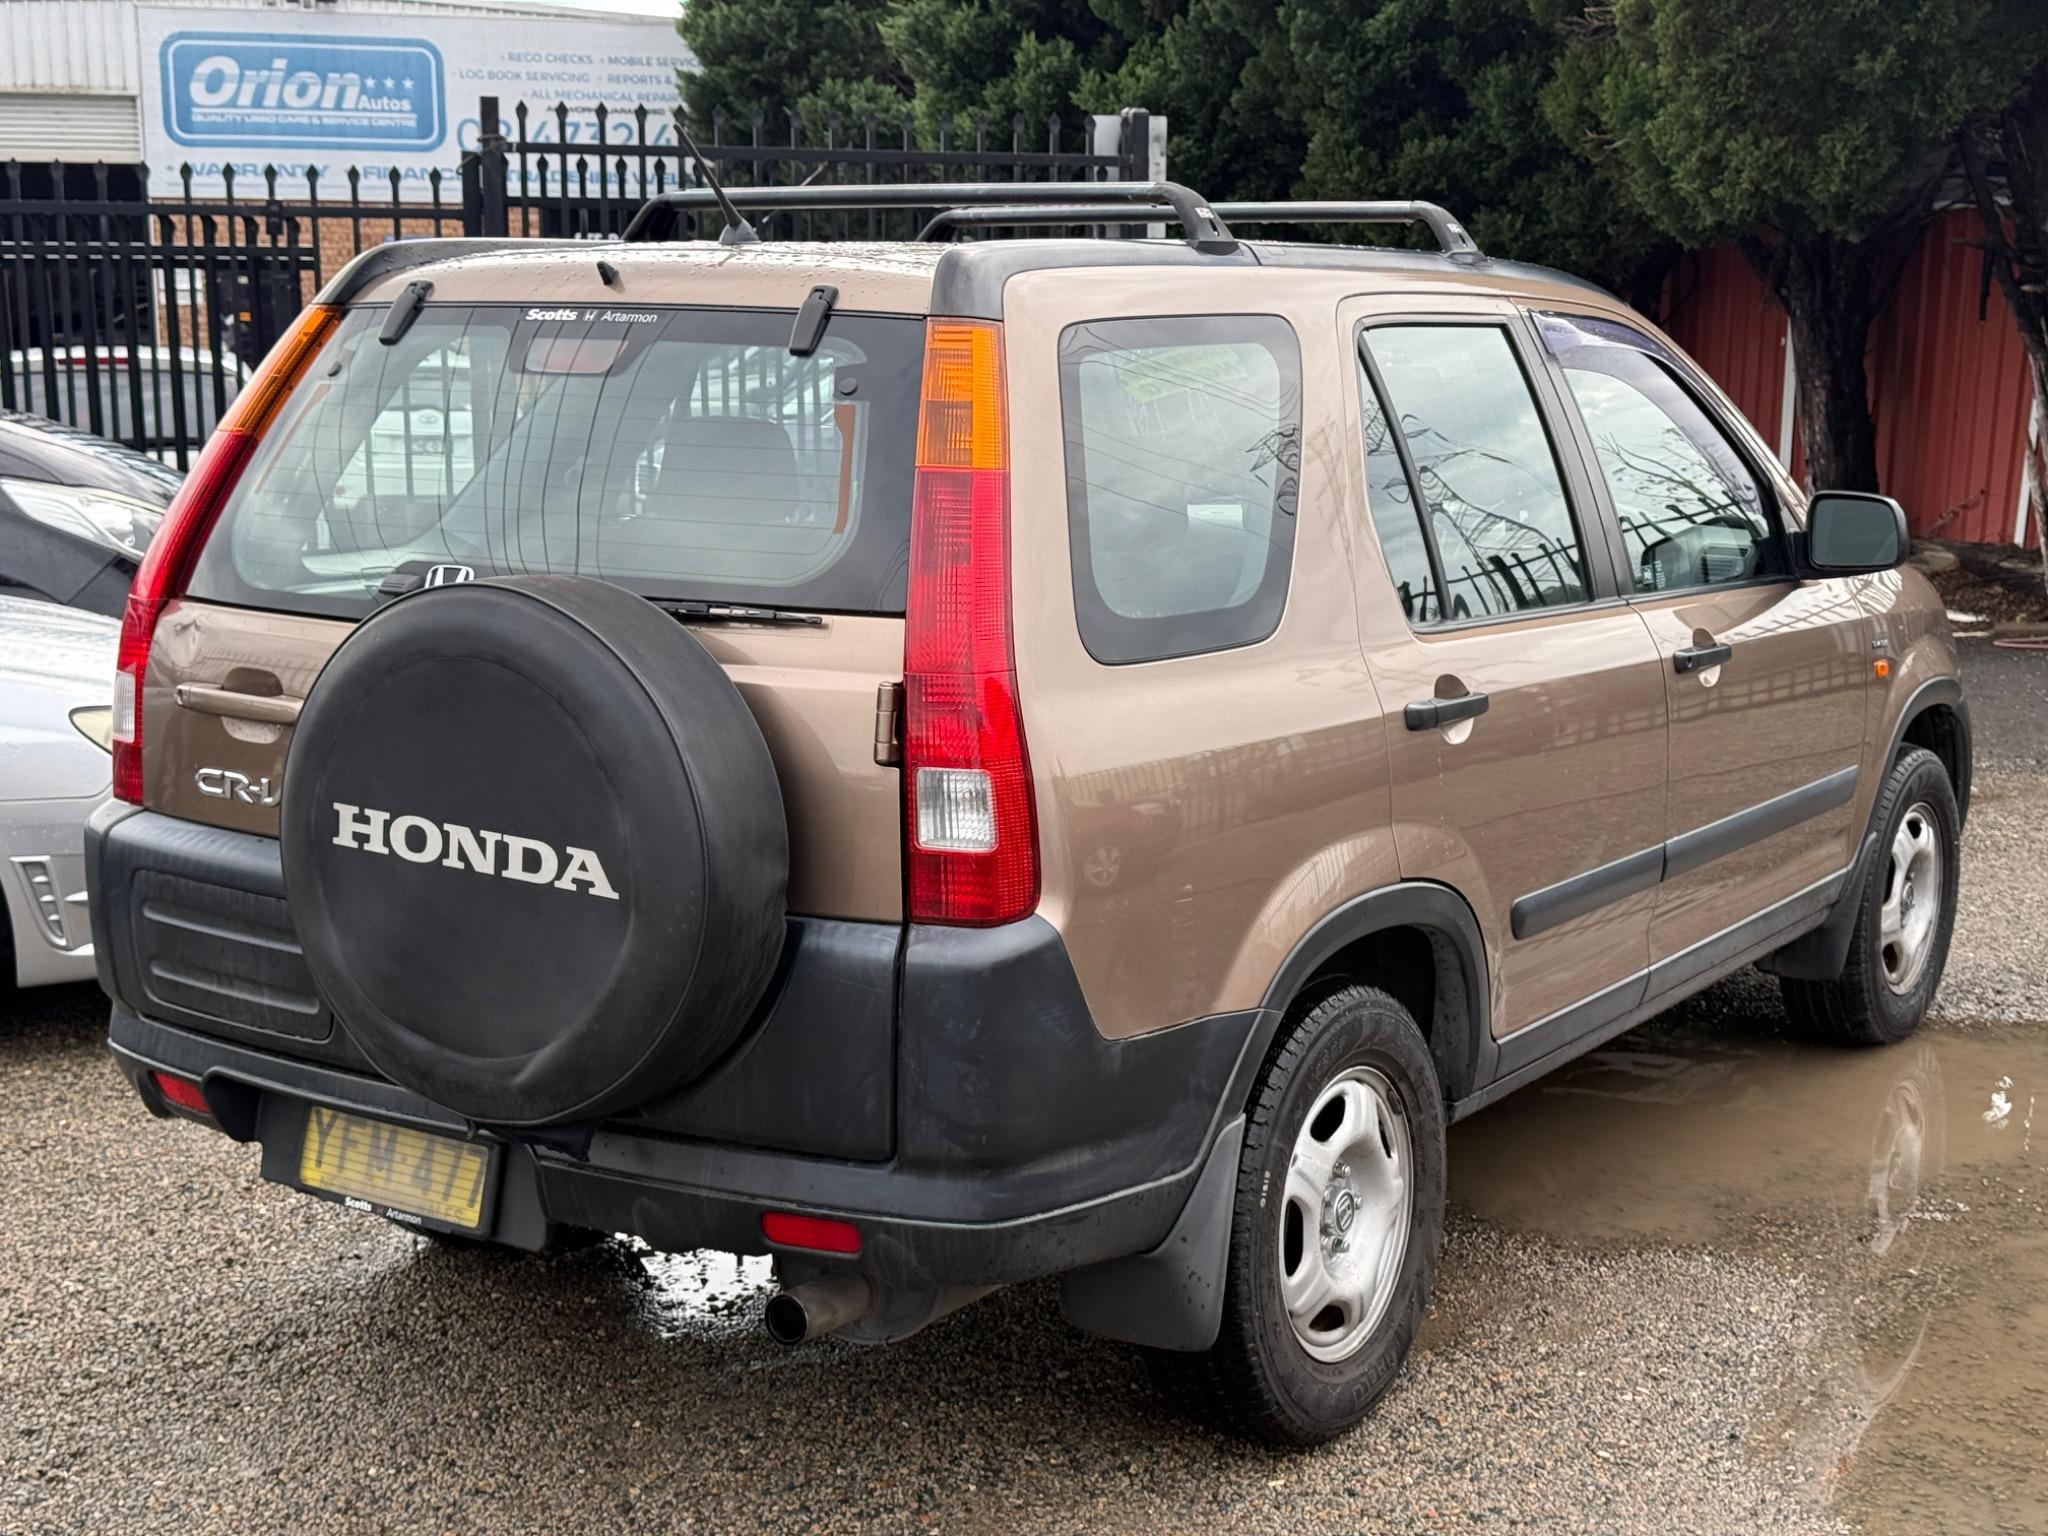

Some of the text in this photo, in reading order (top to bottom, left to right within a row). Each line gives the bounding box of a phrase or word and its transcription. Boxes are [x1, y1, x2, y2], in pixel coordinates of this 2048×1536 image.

[507, 52, 700, 68] REGO CHECKS MOBILE SERVIC
[189, 55, 412, 112] Orion Autos
[459, 68, 484, 80] LOG
[486, 69, 522, 81] BOOK
[525, 71, 591, 83] SERVICING
[607, 73, 660, 85] REPORTS
[530, 88, 680, 103] ALL MECHANICAL REPAIR
[186, 163, 330, 177] WARRNTY
[525, 308, 658, 323] Scotts Artarmon
[332, 801, 620, 900] HONDA
[345, 1196, 422, 1225] Scotts Artarmon
